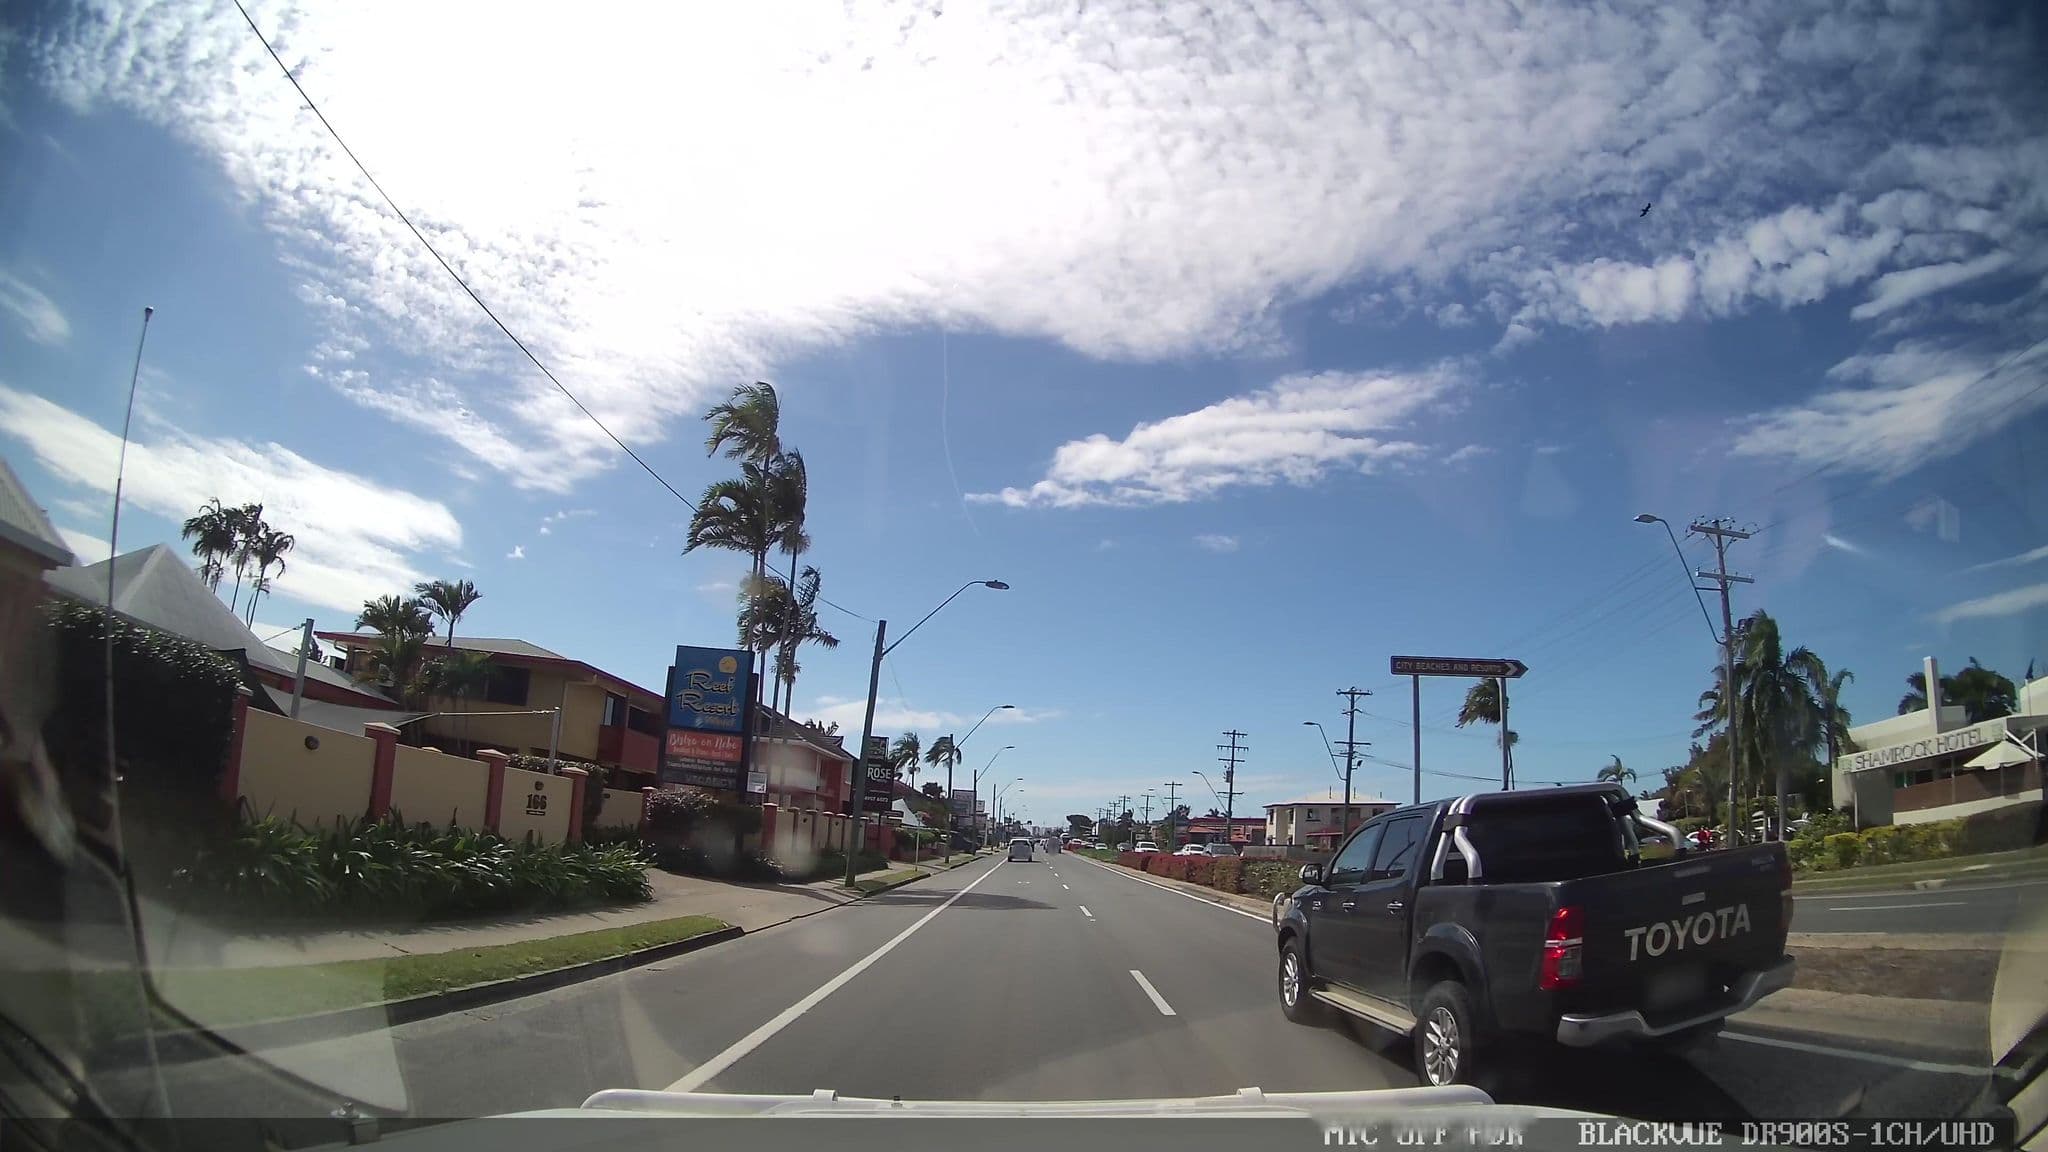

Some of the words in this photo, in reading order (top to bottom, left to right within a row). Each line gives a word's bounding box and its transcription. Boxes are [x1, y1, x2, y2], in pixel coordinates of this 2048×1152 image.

[1396, 661, 1413, 670] CITY
[1416, 662, 1450, 671] BEACHES
[1454, 663, 1469, 672] AND
[1471, 664, 1502, 673] RESORTS
[685, 671, 734, 692] Reef
[677, 690, 736, 715] Resort
[1855, 738, 1933, 771] SHAMROCK
[1936, 728, 1986, 753] HOTEL
[867, 767, 891, 780] ROSE
[526, 794, 547, 809] 166
[1624, 903, 1751, 961] TOYOTA
